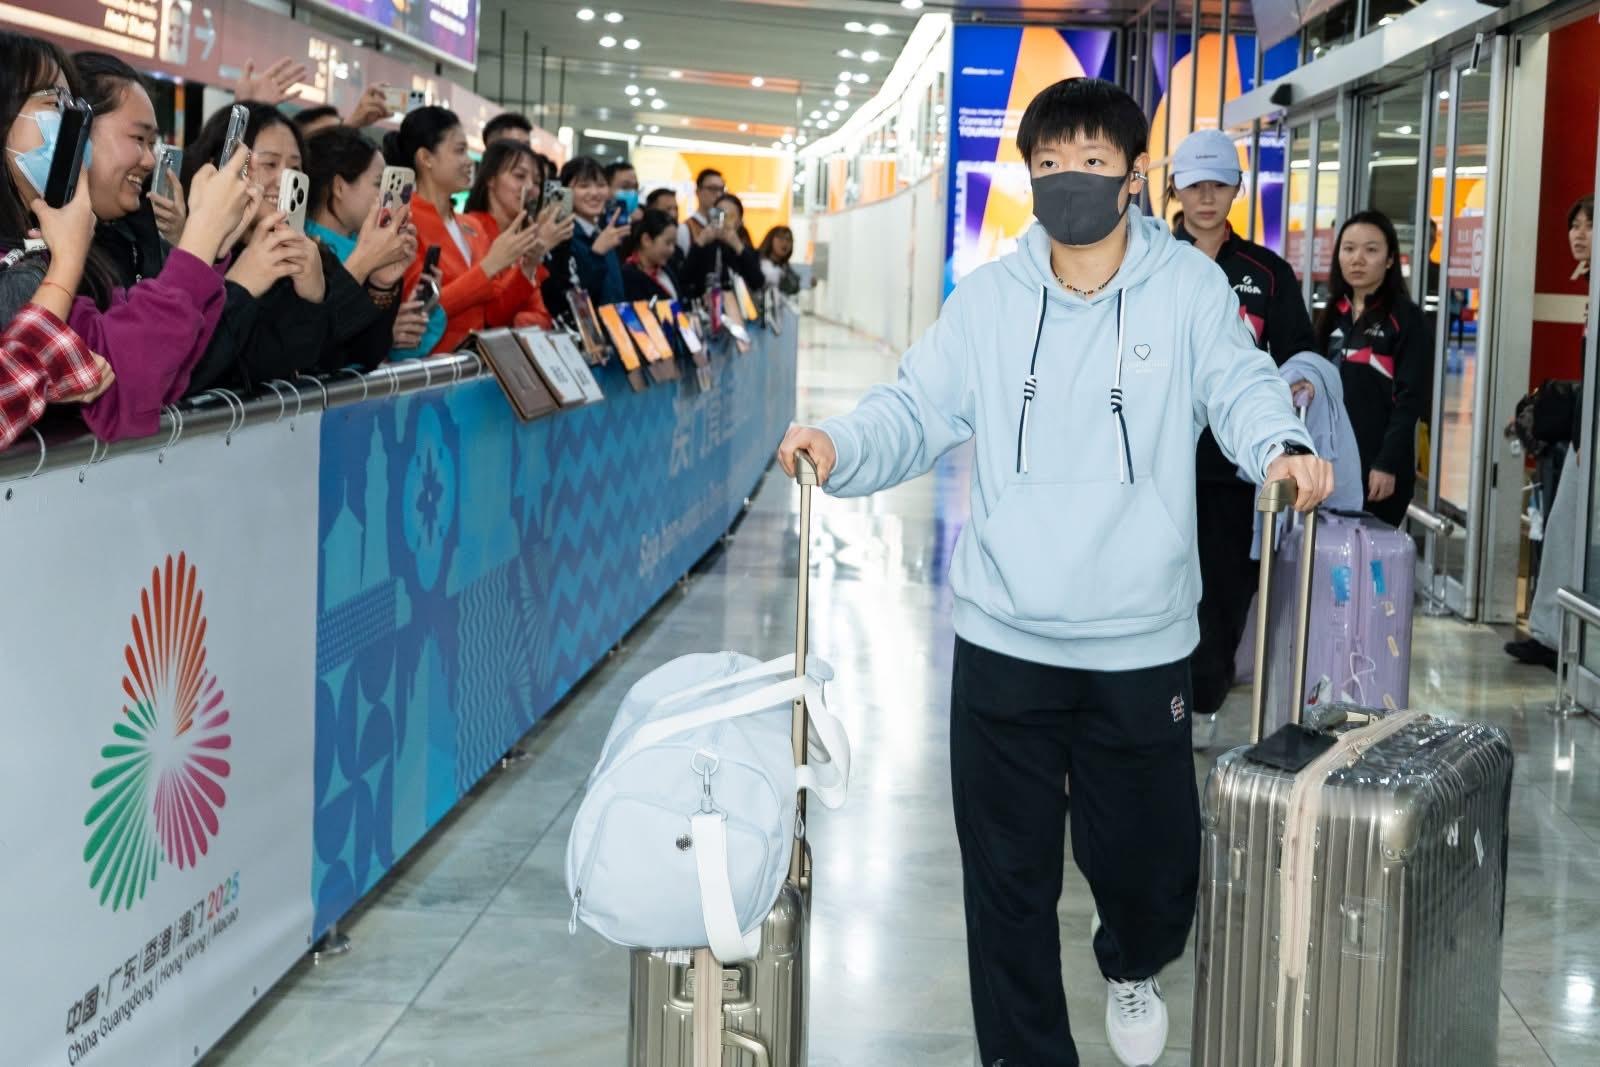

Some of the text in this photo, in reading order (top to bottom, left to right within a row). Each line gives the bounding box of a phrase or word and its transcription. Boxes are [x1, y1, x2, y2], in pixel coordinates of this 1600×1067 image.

[207, 870, 240, 920] 2025
[160, 956, 183, 985] Hong
[185, 934, 206, 961] Kong
[212, 907, 240, 937] Macao
